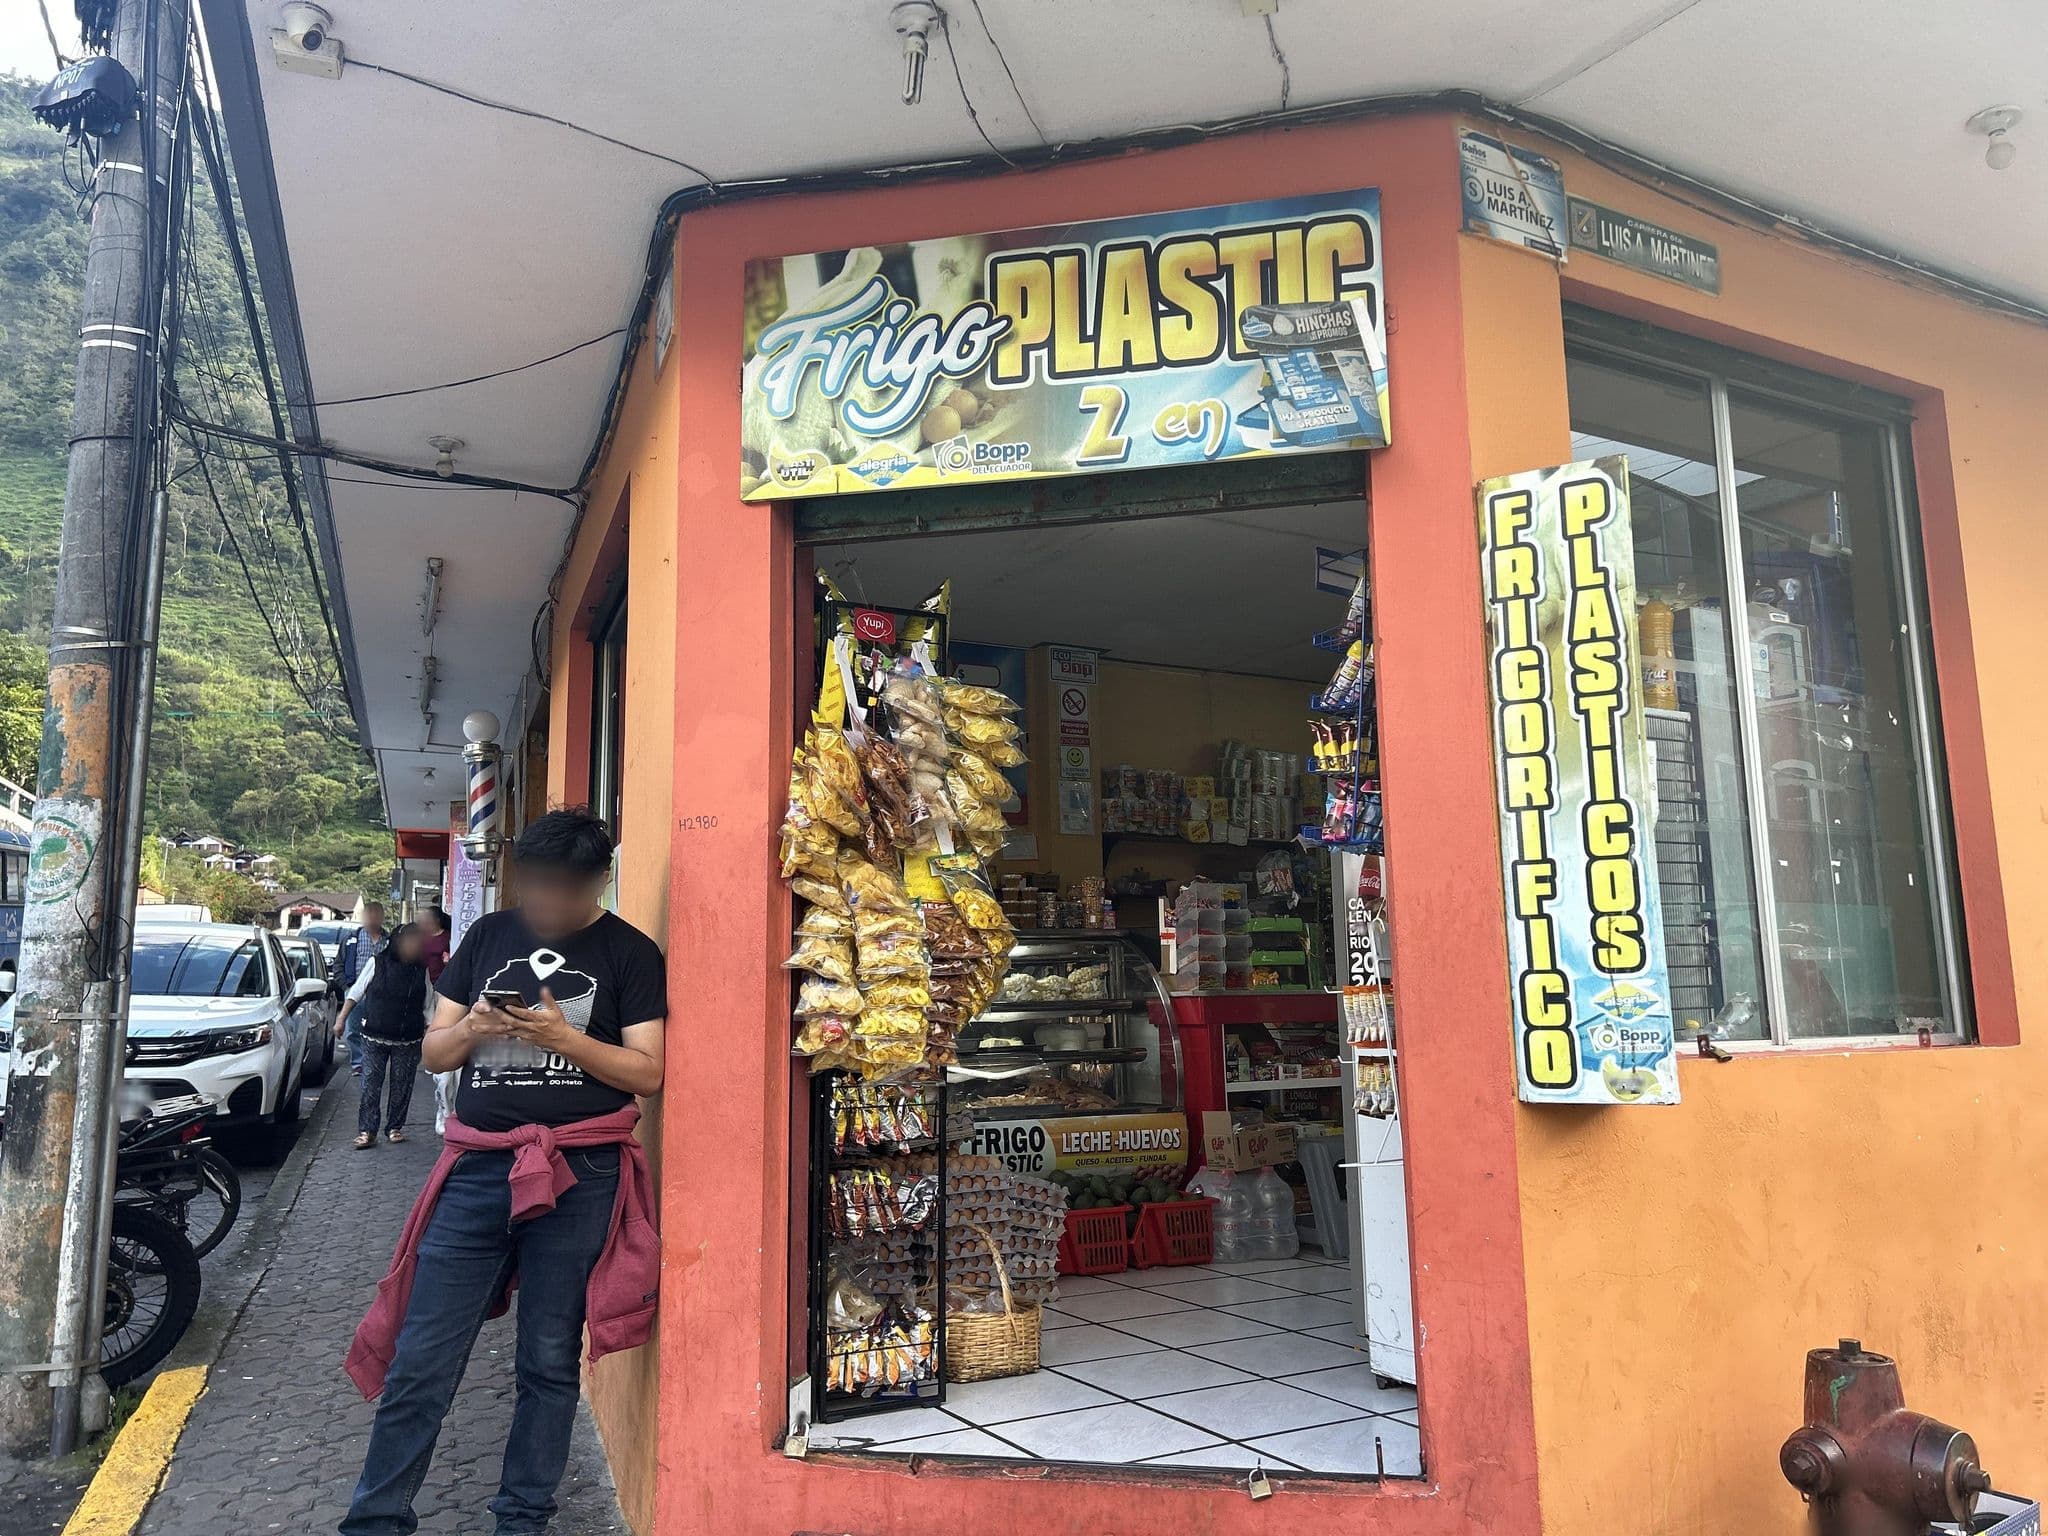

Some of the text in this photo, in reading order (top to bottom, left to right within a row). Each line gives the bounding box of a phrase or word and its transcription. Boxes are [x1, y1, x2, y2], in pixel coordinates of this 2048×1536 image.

[53, 67, 85, 90] NP07
[1486, 180, 1531, 206] LUIS A.
[1487, 196, 1554, 231] MARTÍNEZ
[1601, 220, 1632, 251] LUIS
[1295, 310, 1352, 333] HINCHAS
[1317, 327, 1348, 339] PROMOS
[757, 275, 1012, 434] Frigo
[1280, 405, 1351, 421] ¡MÁ PRODUCTO
[1077, 385, 1230, 466] 2 en
[975, 441, 1030, 463] Bopp
[776, 459, 816, 471] ASTI
[858, 453, 908, 472] alegría
[972, 463, 1032, 474] DEL ECUADOR
[863, 617, 885, 630] Yupi
[1062, 662, 1090, 674] 911
[1559, 477, 1647, 974] PLASTICOS
[1490, 489, 1577, 1089] FRIGORIFICO
[679, 815, 719, 832] H2980
[1348, 898, 1365, 910] CA
[1349, 910, 1371, 923] LEN
[1350, 937, 1370, 949] RIO
[1351, 952, 1375, 974] 20
[1620, 1029, 1660, 1044] Bopp
[971, 1126, 1045, 1155] FRIGO
[1062, 1131, 1111, 1153] LECHE
[1075, 1154, 1167, 1167] QUESO ACEITES FUNDAS
